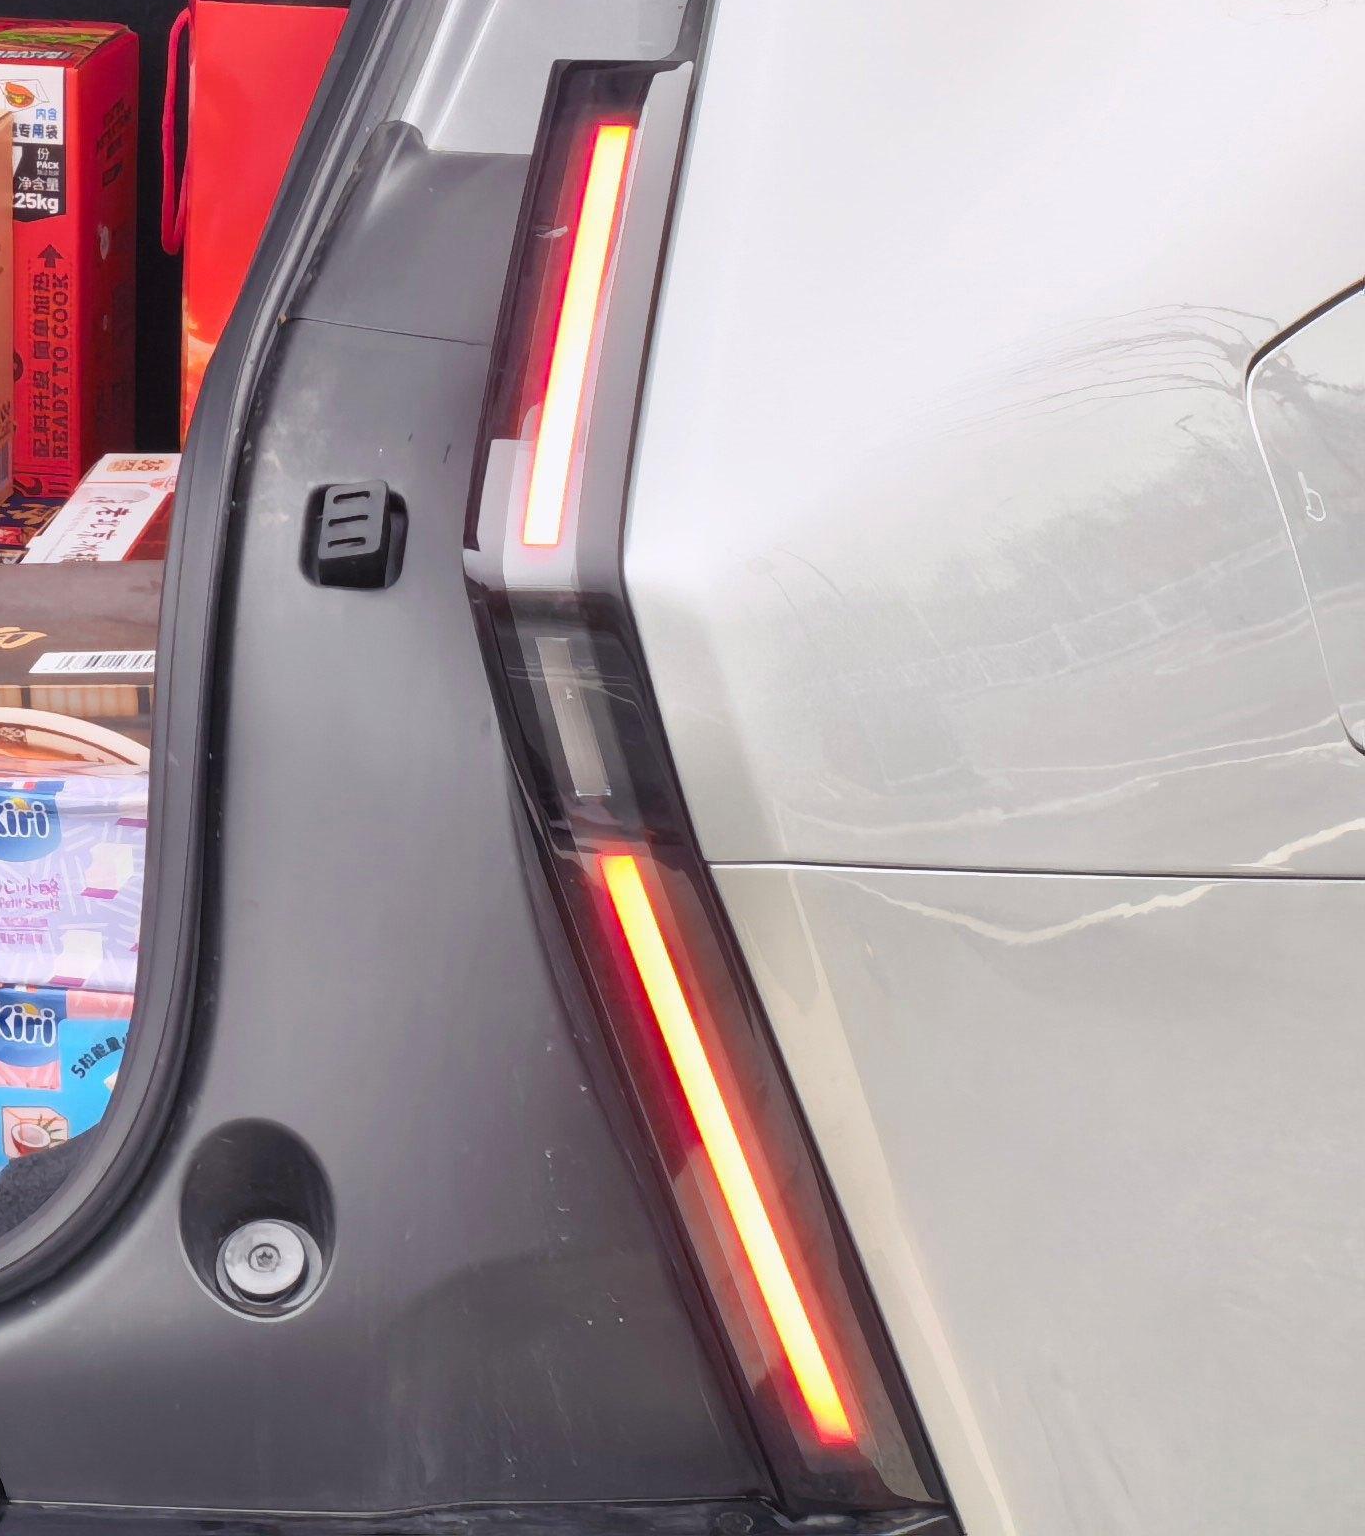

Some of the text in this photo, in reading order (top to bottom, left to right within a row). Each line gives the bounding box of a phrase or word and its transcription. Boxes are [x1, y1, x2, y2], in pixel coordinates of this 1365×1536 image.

[36, 160, 60, 170] PACK
[18, 176, 59, 192] 净含量
[52, 273, 69, 460] READY TO COOK
